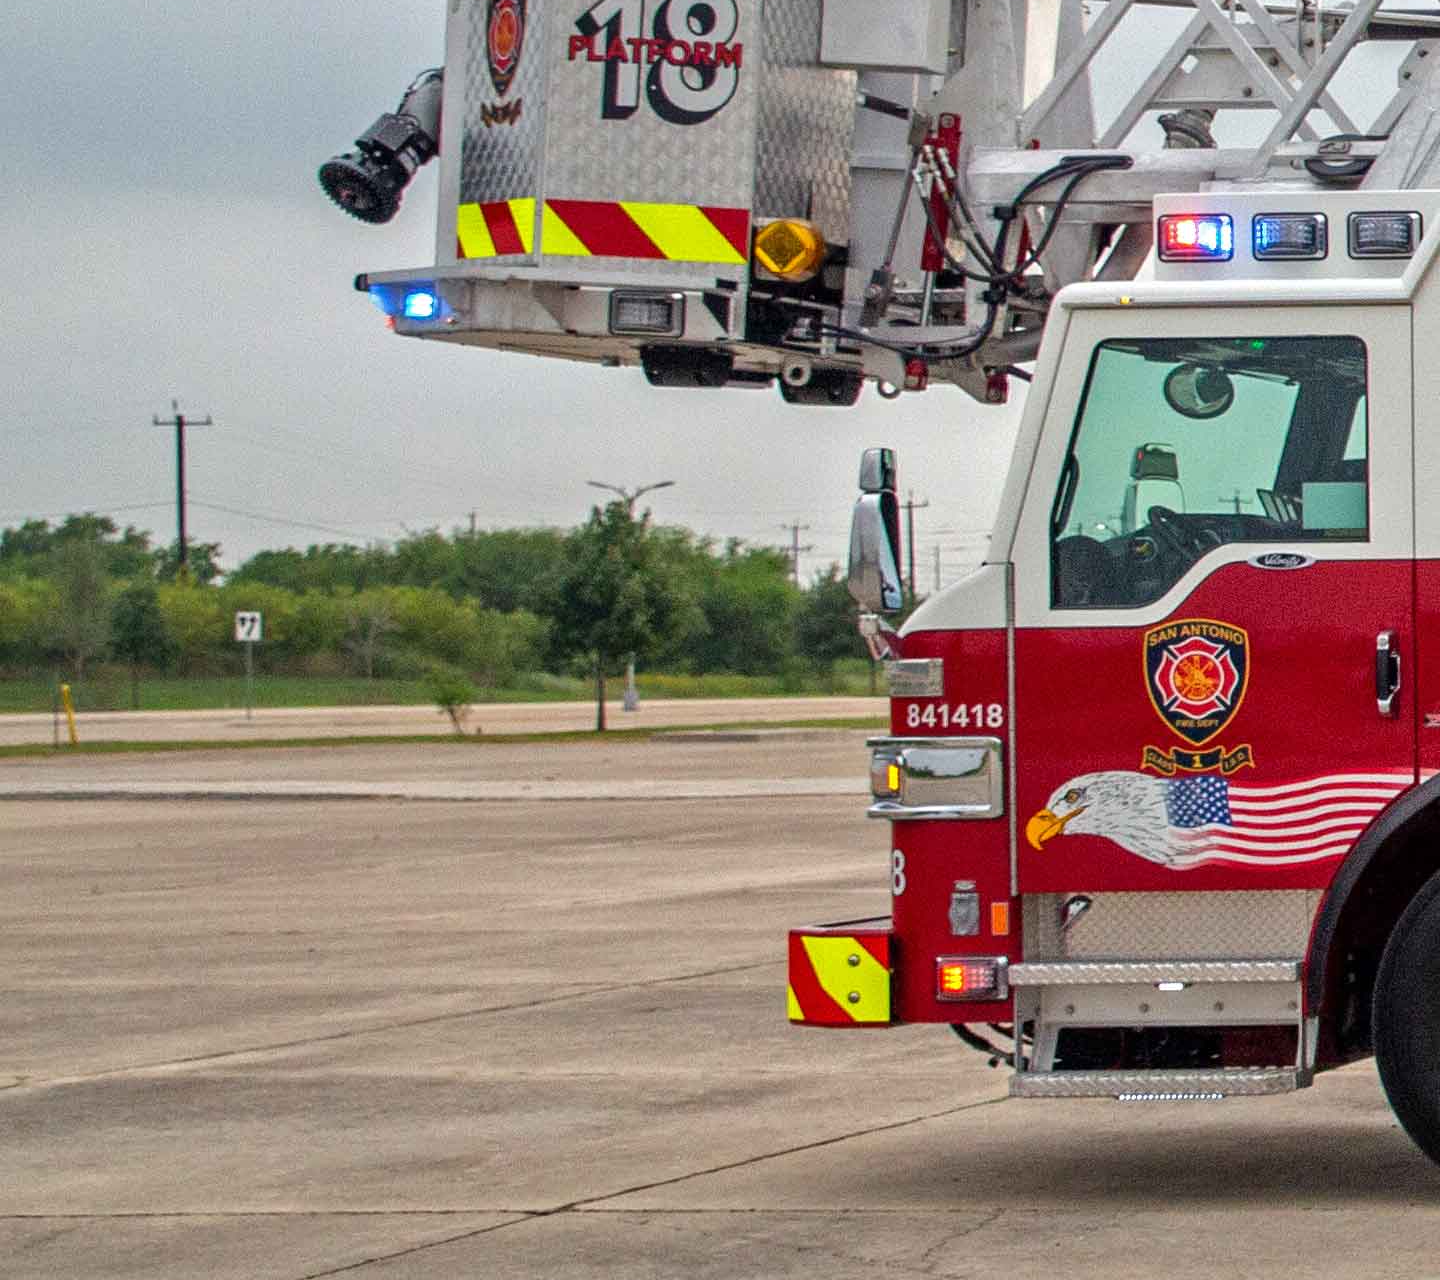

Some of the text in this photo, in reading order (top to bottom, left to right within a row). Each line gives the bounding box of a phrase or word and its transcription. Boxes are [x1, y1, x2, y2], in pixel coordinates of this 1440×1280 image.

[567, 34, 744, 68] PLATFORM
[1148, 623, 1245, 647] SAN ANTONIO
[906, 703, 1004, 729] 841418
[1192, 754, 1203, 768] 1
